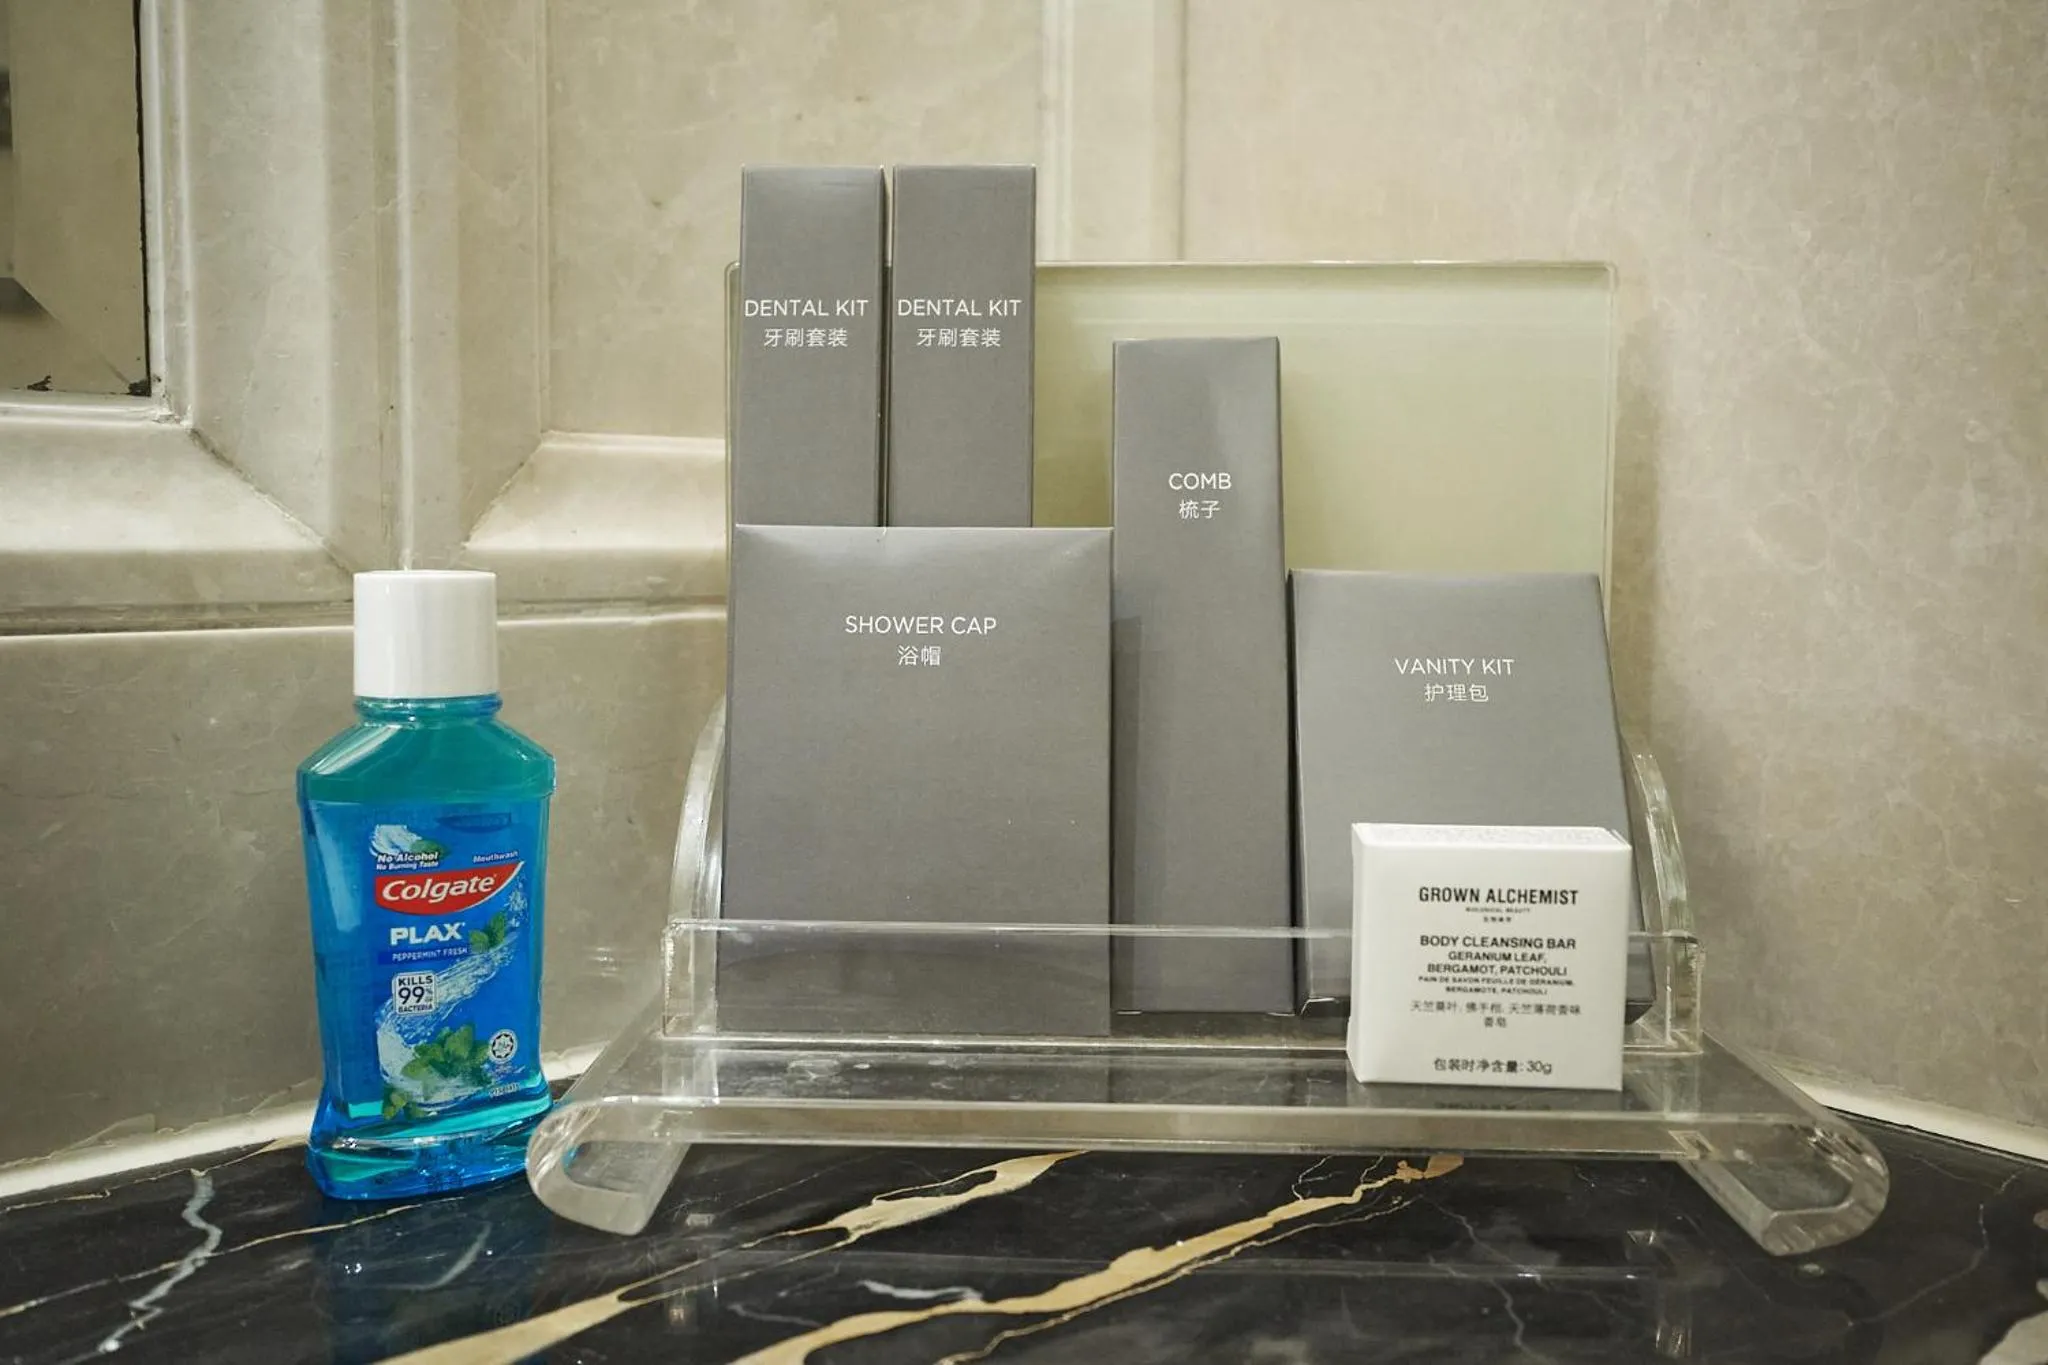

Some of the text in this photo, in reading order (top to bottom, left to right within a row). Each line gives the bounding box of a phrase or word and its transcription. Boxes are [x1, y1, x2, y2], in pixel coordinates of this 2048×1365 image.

[745, 299, 869, 316] DENTAL KIT
[897, 299, 1022, 316] DENTAL KIT
[764, 328, 848, 347] 牙刷套装
[917, 328, 1001, 347] 牙刷套装
[1168, 472, 1232, 490] COMB
[1179, 499, 1221, 519] 梳子
[845, 615, 997, 634] SHOWER CAP
[898, 645, 942, 666] 浴帽
[1394, 657, 1515, 675] VANITY KIT
[1424, 683, 1489, 702] 护理包
[377, 851, 439, 863] No Alcohol
[382, 875, 495, 904] Colgate
[1419, 886, 1579, 905] GROWN ALCHEMIST
[390, 922, 462, 946] PLAX
[1420, 935, 1577, 950] BODY CLEANSING BAR
[392, 947, 468, 961] PEPPERMINT FRESH
[1448, 951, 1512, 962] GERANIUM
[1427, 963, 1568, 977] BERGAMOT, PATCHOULI
[398, 976, 433, 987] KILLS
[398, 1003, 433, 1013] BACTERIA
